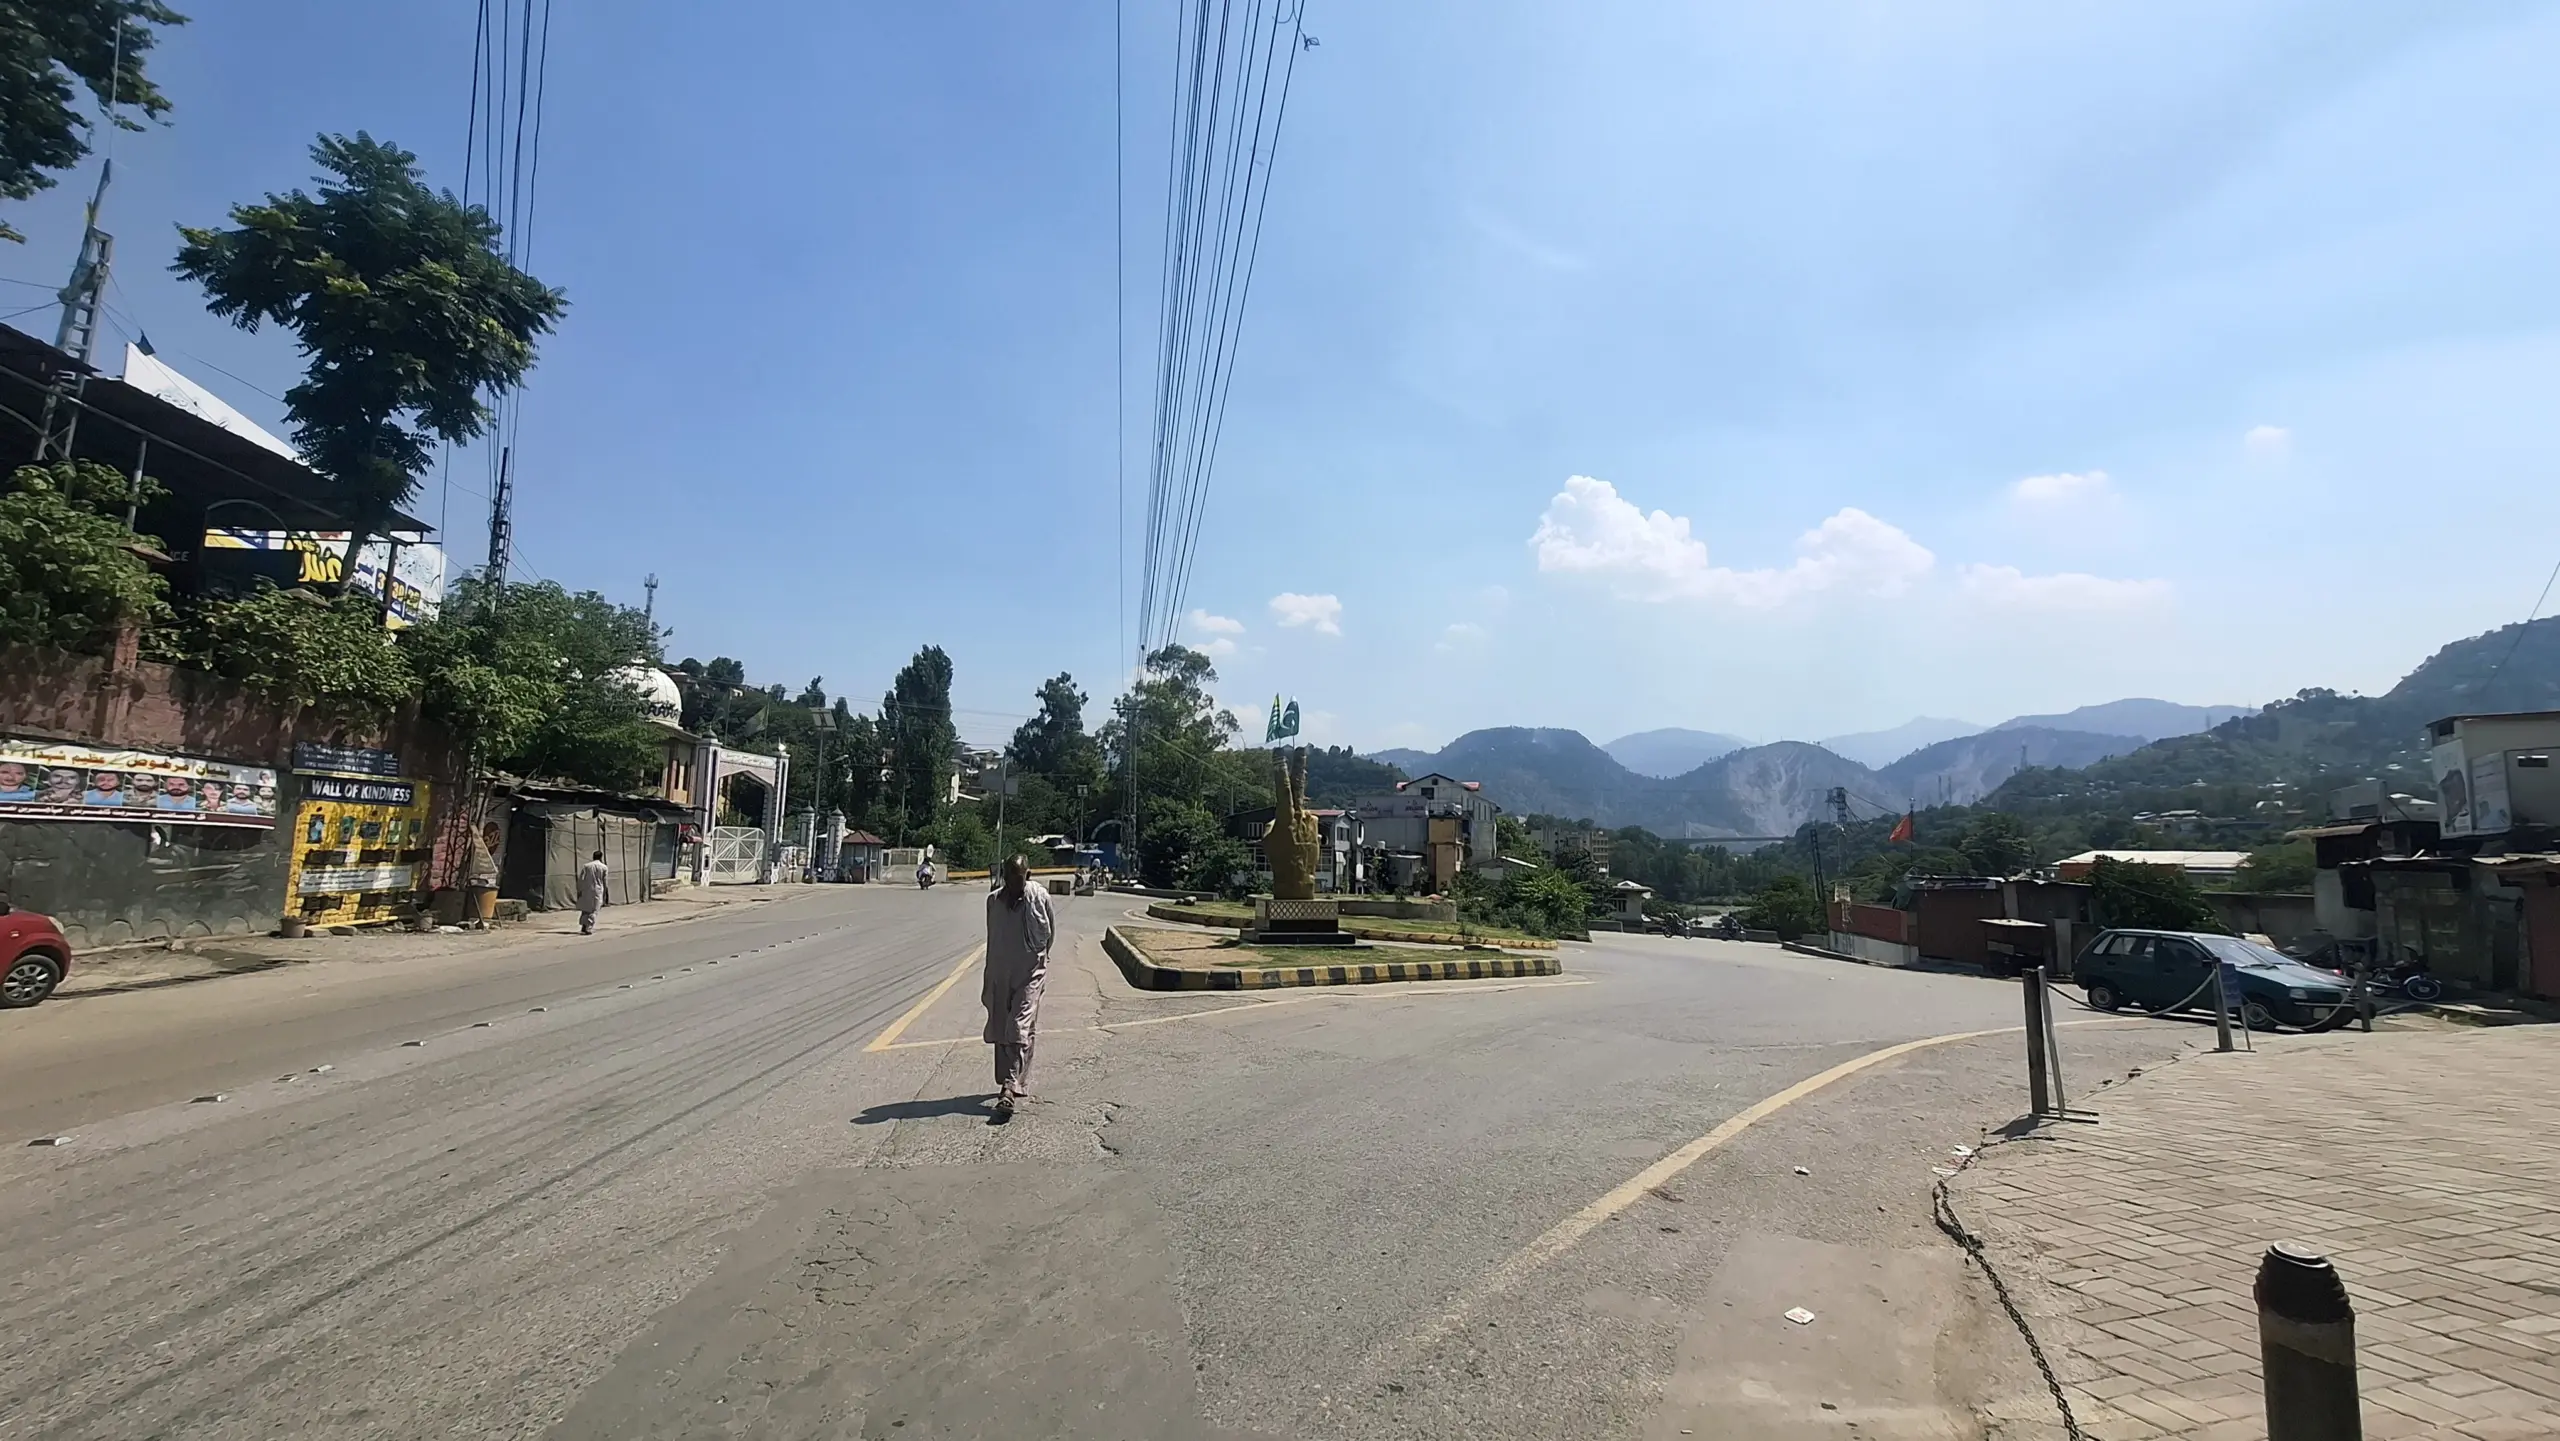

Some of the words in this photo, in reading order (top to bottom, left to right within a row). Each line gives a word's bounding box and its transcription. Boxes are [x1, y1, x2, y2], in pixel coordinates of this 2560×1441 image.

[311, 779, 342, 798] WALL
[344, 783, 360, 798] OF
[360, 784, 412, 803] KINDNESS
